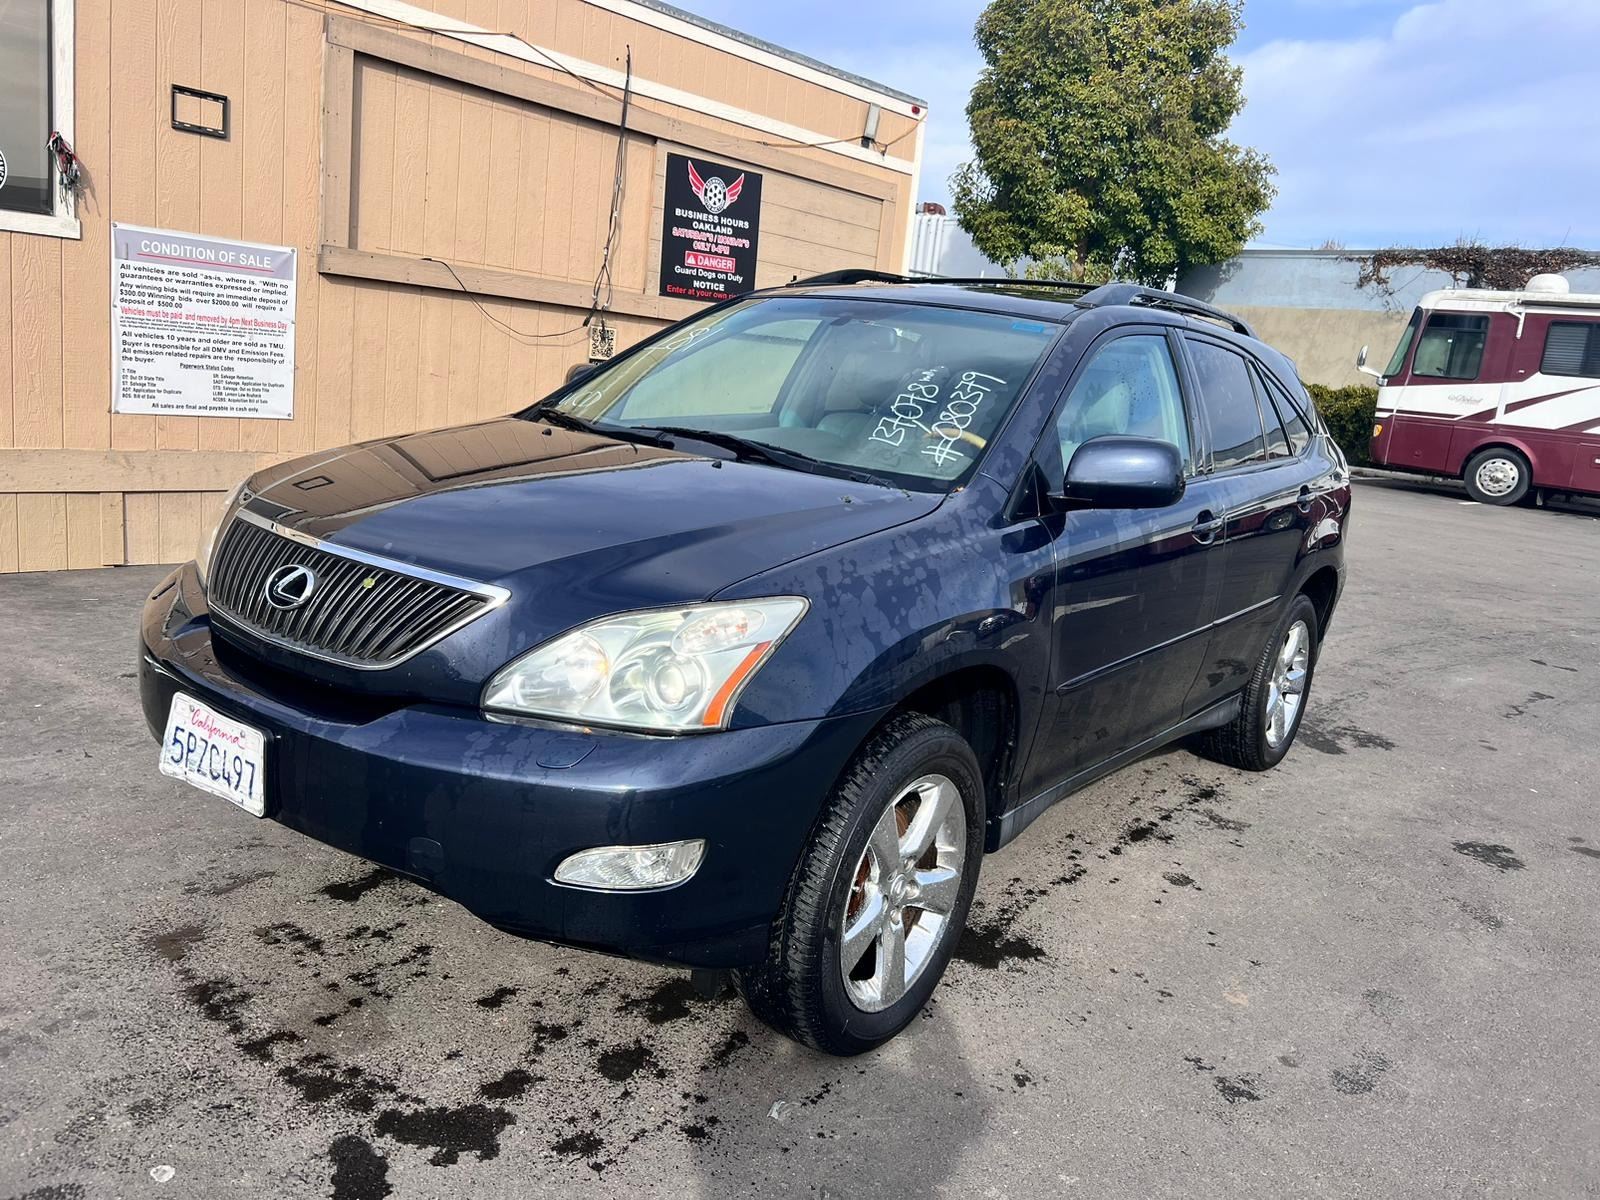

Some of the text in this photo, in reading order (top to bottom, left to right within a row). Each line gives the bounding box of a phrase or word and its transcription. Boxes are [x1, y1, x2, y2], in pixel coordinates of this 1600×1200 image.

[675, 208, 749, 229] BUSINESS HOURS
[692, 221, 733, 235] OAKLAND
[141, 240, 272, 268] CONDITION OF SALE
[697, 256, 733, 270] DANGER
[133, 265, 165, 275] vehicles
[674, 265, 743, 284] Guard Dogs on Duty
[120, 272, 163, 282] guarantees
[175, 278, 213, 288] warranties
[215, 283, 252, 292] expressed
[693, 280, 725, 291] NOTICE
[120, 281, 133, 289] Any
[135, 283, 162, 293] winning
[192, 290, 215, 298] require
[226, 292, 257, 302] immediate
[259, 297, 281, 305] deposit
[120, 288, 146, 298] $300.00
[147, 291, 175, 302] Winning
[178, 295, 193, 303] bids
[212, 298, 239, 308] $2000.00
[255, 304, 276, 312] require
[666, 285, 686, 294] Enter
[687, 287, 695, 295] at
[696, 289, 712, 298] your
[120, 297, 146, 305] deposit
[121, 306, 145, 316] Vehicles
[146, 310, 160, 318] must
[162, 310, 170, 318] be
[170, 311, 183, 320] paid
[185, 312, 196, 320] and
[197, 314, 220, 324] removed
[221, 315, 228, 325] by
[229, 317, 240, 326] 4pm
[241, 318, 253, 326] Next
[254, 319, 277, 329] Business
[278, 321, 288, 330] Day
[134, 331, 165, 340] vehicles
[122, 339, 142, 348] Buyer
[152, 342, 191, 351] responsible
[241, 349, 269, 357] Emission
[133, 348, 164, 356] emission
[165, 350, 188, 358] related
[189, 352, 211, 360] repairs
[237, 356, 277, 365] responsibility
[180, 362, 204, 370] Paperwork
[191, 708, 245, 749] California
[171, 725, 255, 800] 5PZC497
